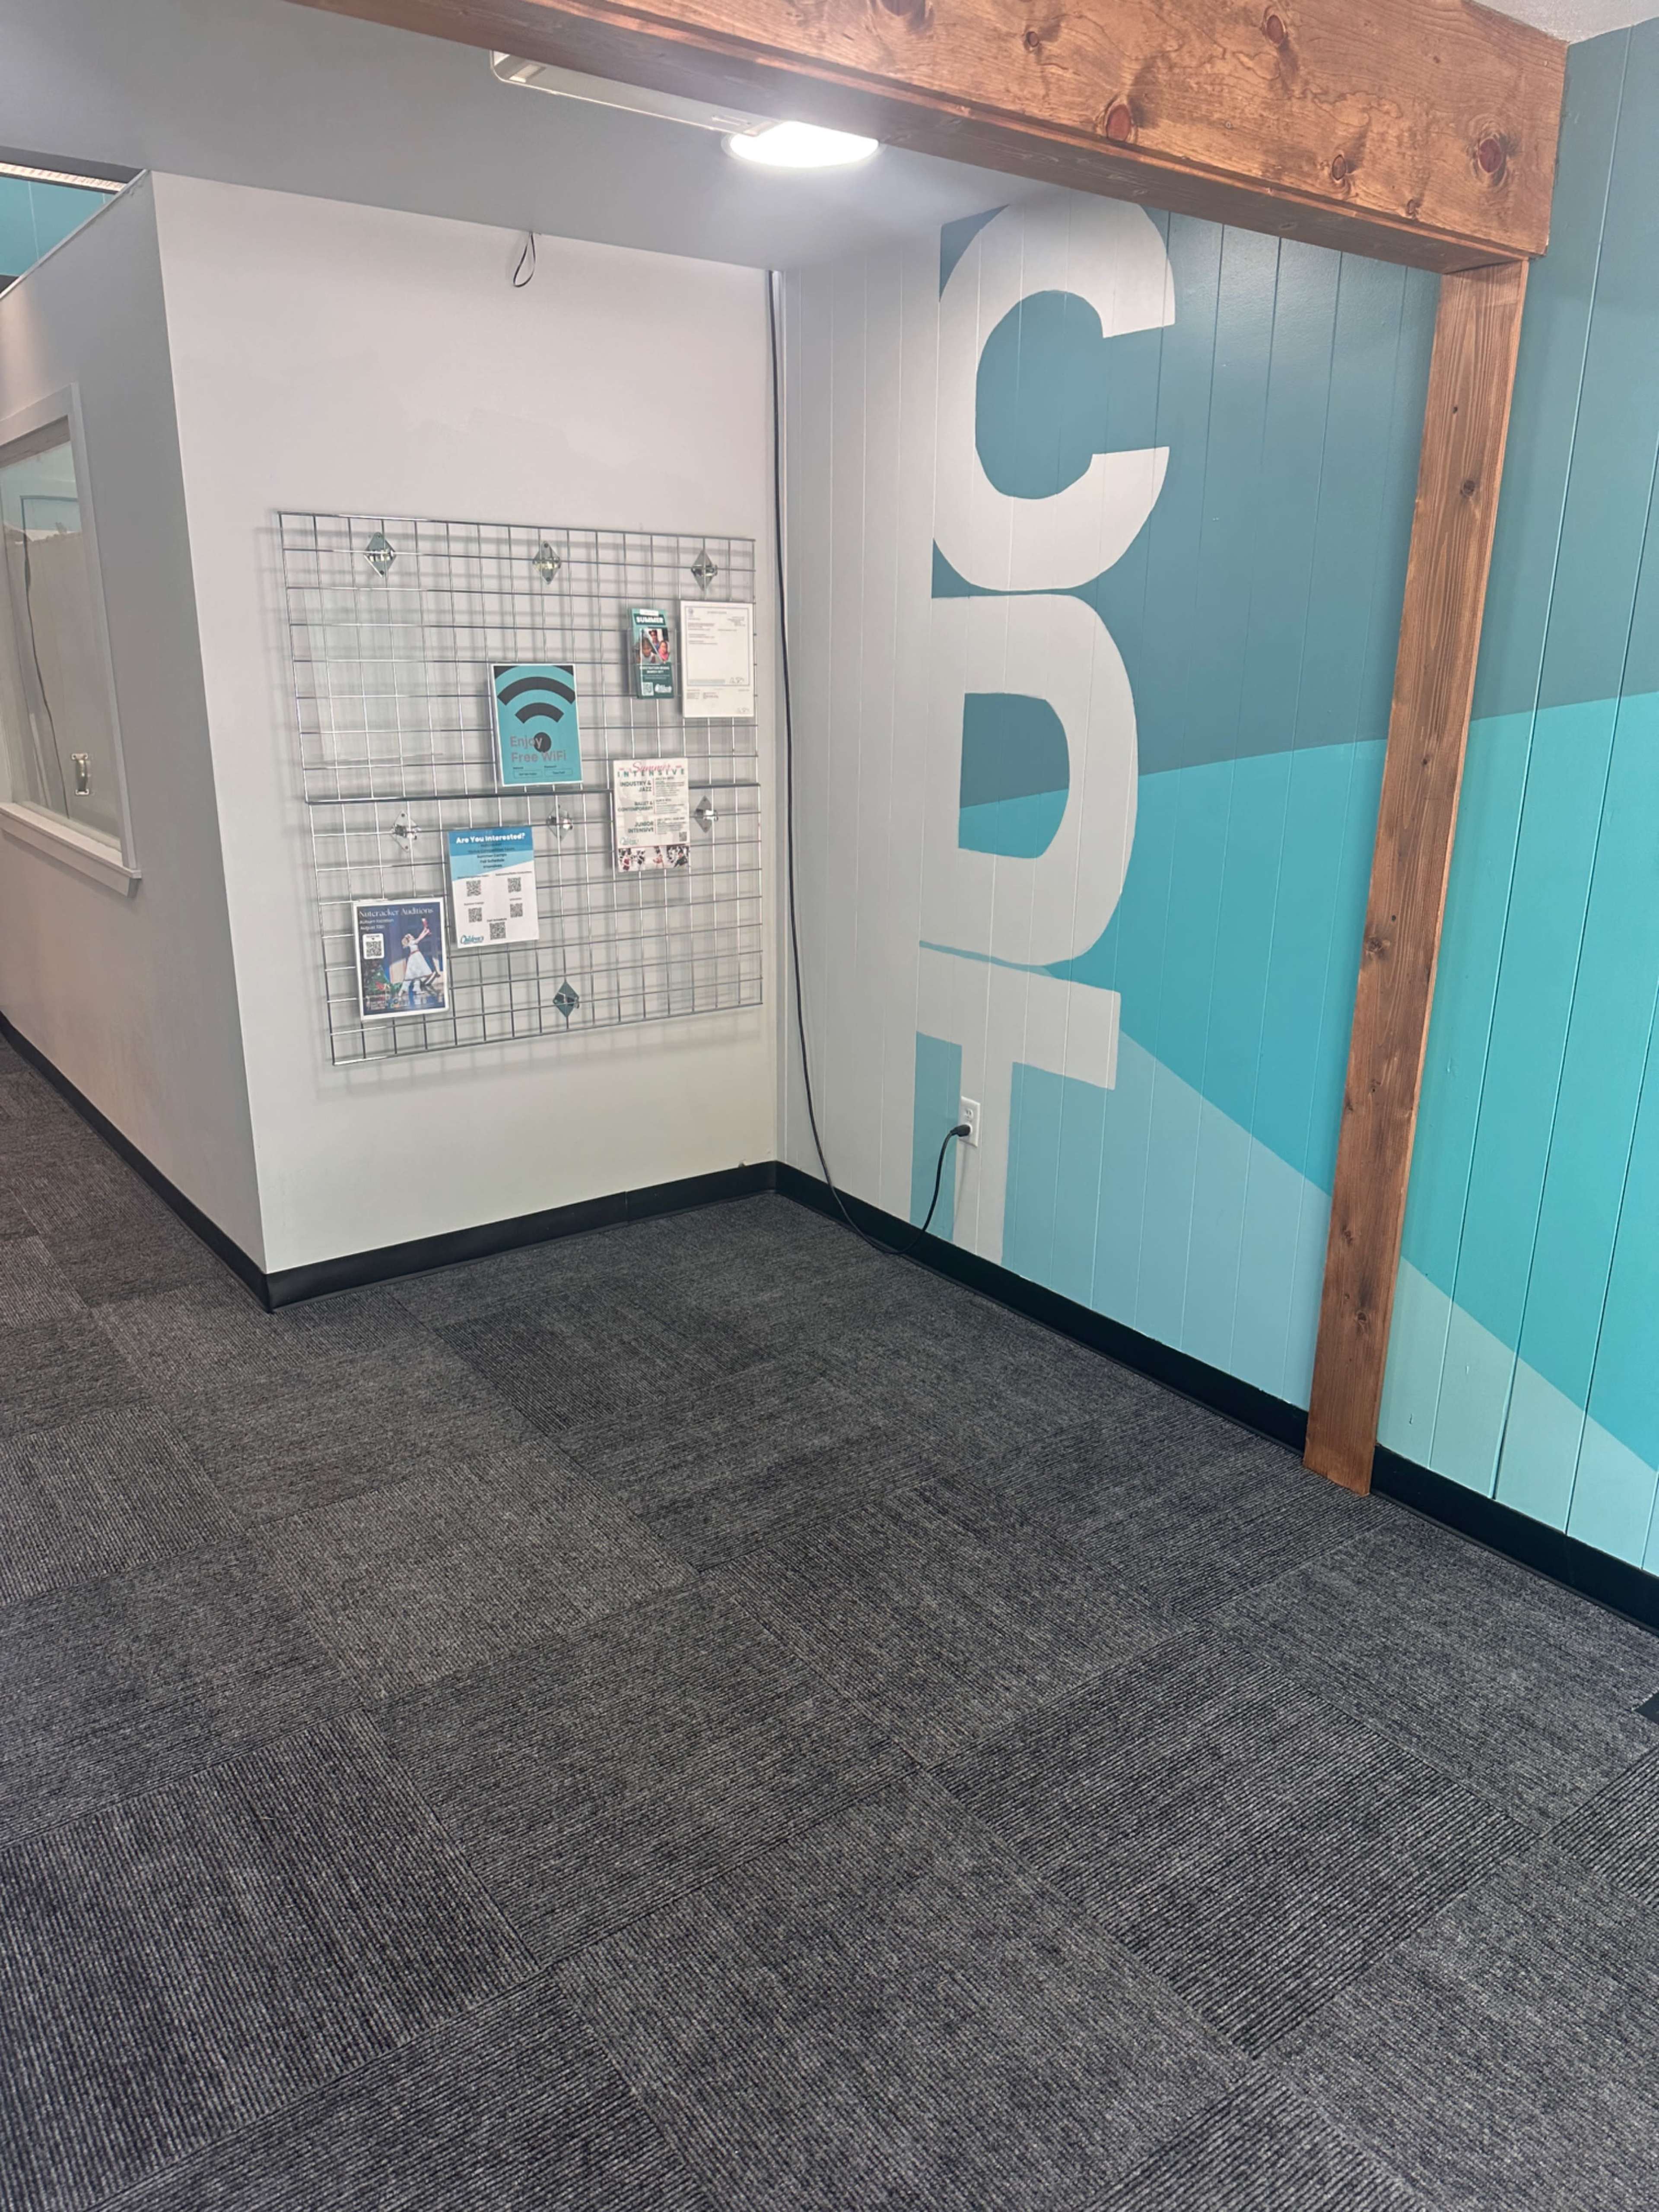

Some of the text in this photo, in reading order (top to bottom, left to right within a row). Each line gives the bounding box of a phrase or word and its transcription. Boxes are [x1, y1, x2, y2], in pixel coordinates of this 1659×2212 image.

[509, 735, 543, 749] Enjoy
[511, 750, 566, 763] Free WiFi
[617, 769, 685, 777] INTENSIVE
[485, 833, 525, 842] Interested?
[359, 908, 399, 917] Nutcracker
